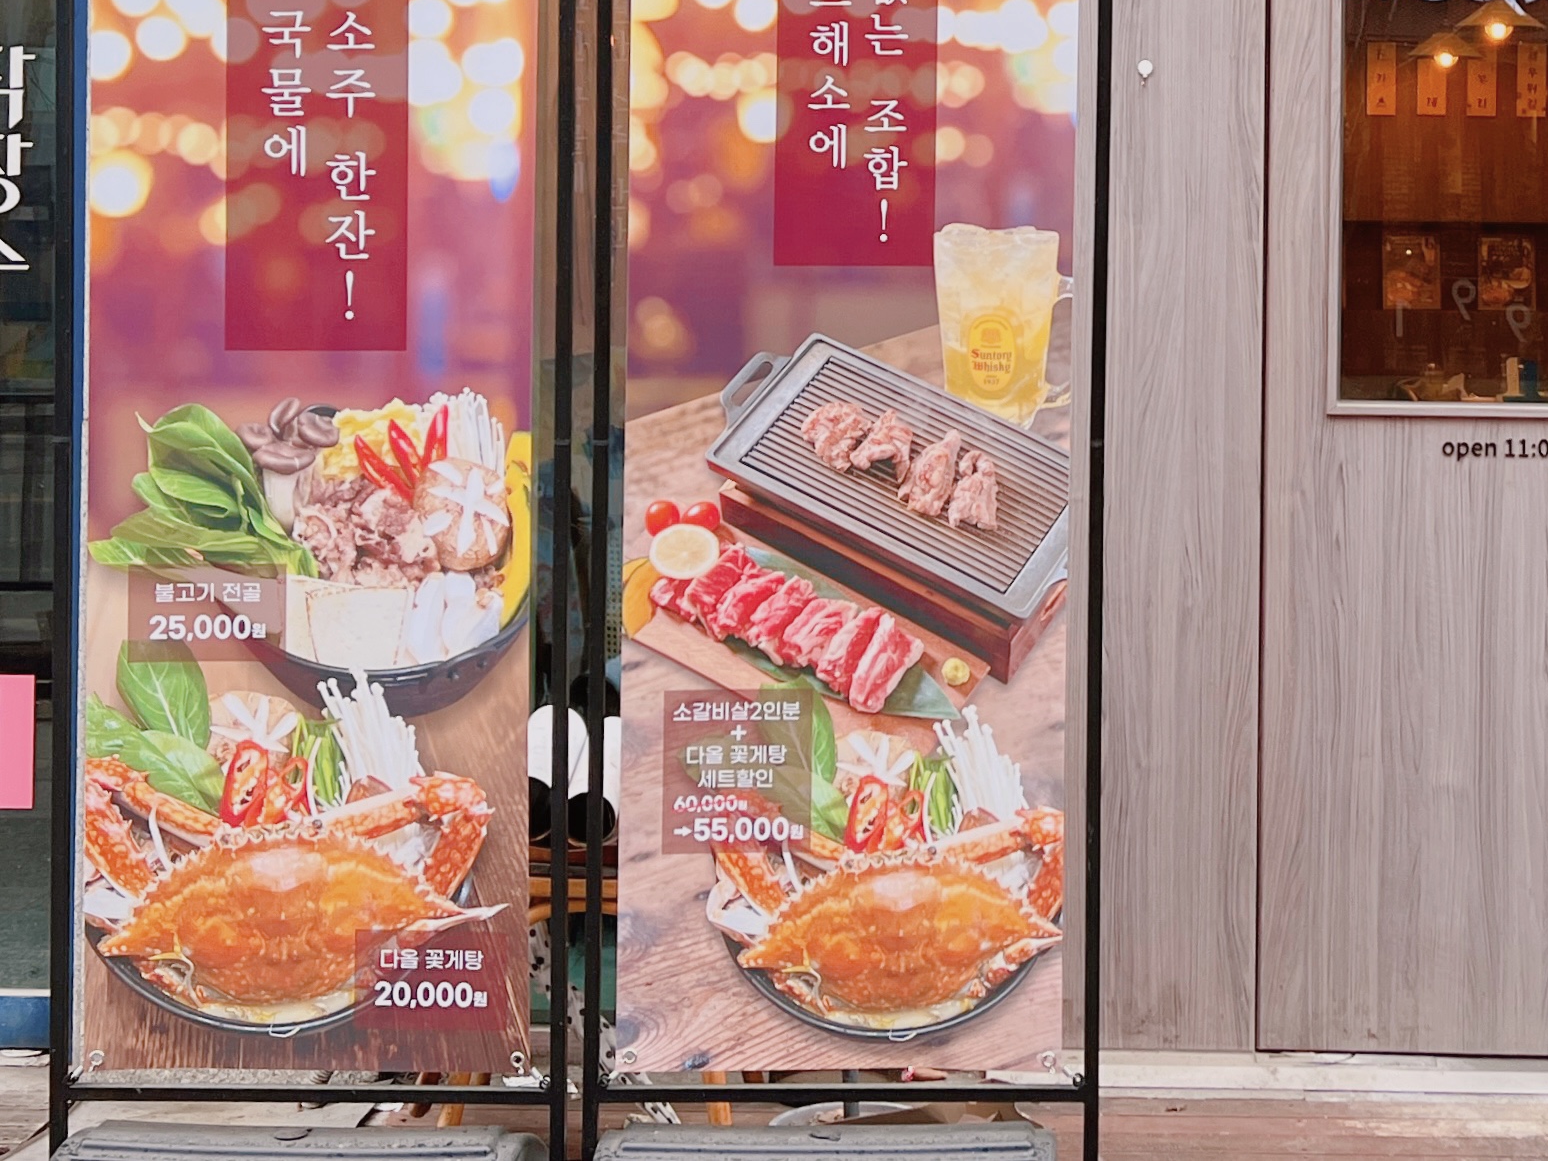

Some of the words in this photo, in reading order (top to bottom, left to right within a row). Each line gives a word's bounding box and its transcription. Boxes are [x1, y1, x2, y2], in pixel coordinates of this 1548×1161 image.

[326, 10, 376, 118] 소주
[261, 9, 312, 177] 국물에
[863, 99, 907, 243] 조합!
[971, 349, 1012, 361] Suntory
[972, 361, 1011, 373] Whisky
[1442, 441, 1497, 461] open
[155, 582, 215, 602] 불고기
[222, 582, 261, 602] 전골
[149, 614, 267, 642] 25,000원
[673, 701, 801, 721] 소갈비살2인분
[686, 745, 723, 765] 다올
[730, 745, 787, 765] 꽃게탕
[698, 769, 773, 788] 세트할인
[693, 817, 804, 843] 55,000원
[380, 948, 419, 969] 다올
[425, 949, 484, 970] 꽃게탕
[374, 981, 488, 1009] 20,000원
